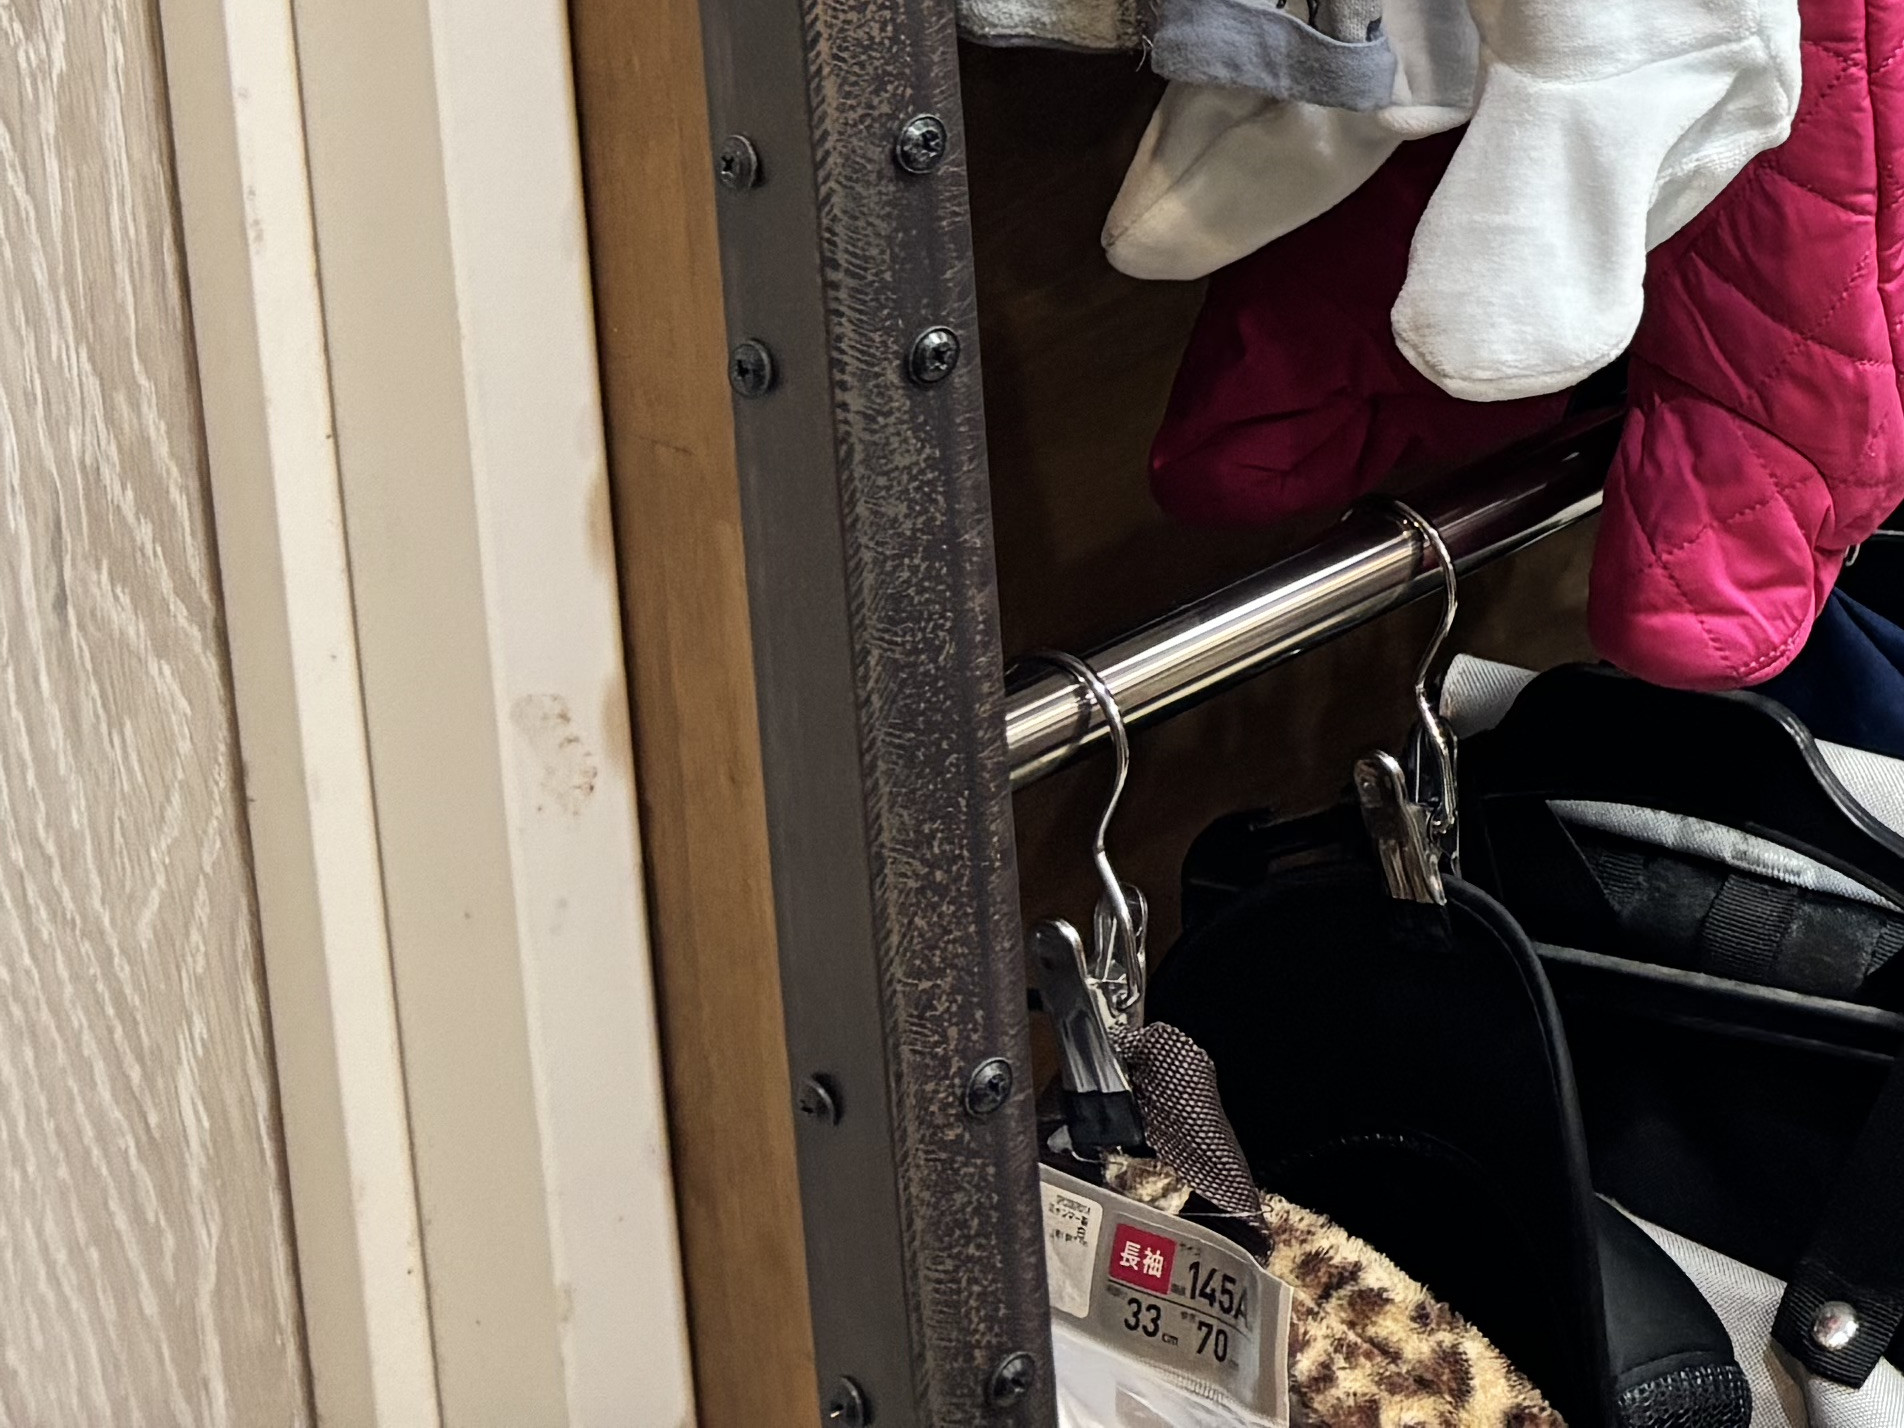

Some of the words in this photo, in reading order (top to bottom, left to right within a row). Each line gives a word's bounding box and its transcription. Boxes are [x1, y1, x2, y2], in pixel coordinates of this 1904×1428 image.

[1119, 1240, 1164, 1278] 長袖
[1123, 1297, 1162, 1338] 33
[1196, 1319, 1229, 1363] 70
